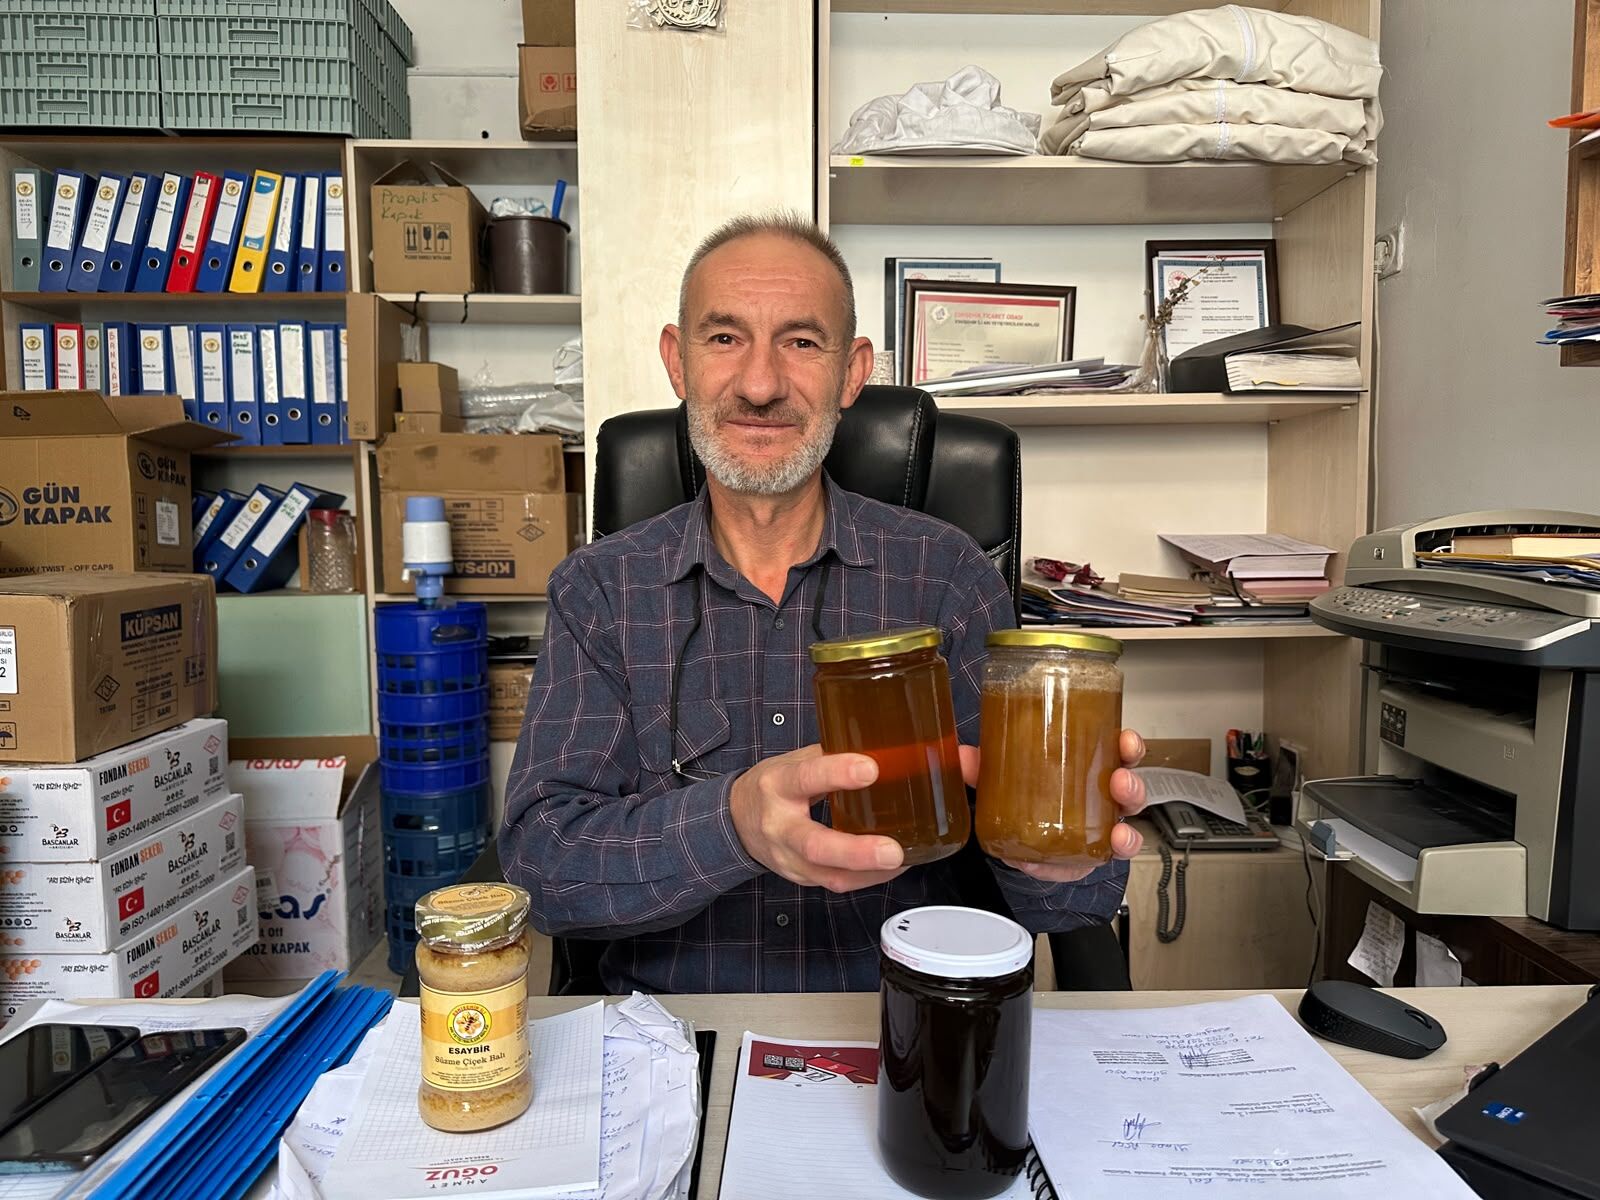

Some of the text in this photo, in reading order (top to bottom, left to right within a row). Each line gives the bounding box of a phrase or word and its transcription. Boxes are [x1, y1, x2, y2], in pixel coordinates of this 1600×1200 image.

[158, 470, 186, 487] KAPAK
[23, 482, 80, 504] GÜN
[24, 506, 112, 525] KAPAK
[454, 562, 510, 577] KÜPSA
[126, 611, 178, 638] KÜPSAN
[99, 764, 128, 786] FONDAN
[111, 853, 139, 878] FONDAN
[127, 937, 156, 964] FONDAN
[271, 942, 310, 955] KAPAK
[448, 1045, 490, 1054] ESAYBİR
[435, 1053, 505, 1066] Süzme Çiçek Balı
[425, 1166, 498, 1181] OĞUZ
[429, 1179, 487, 1189] AHMET
